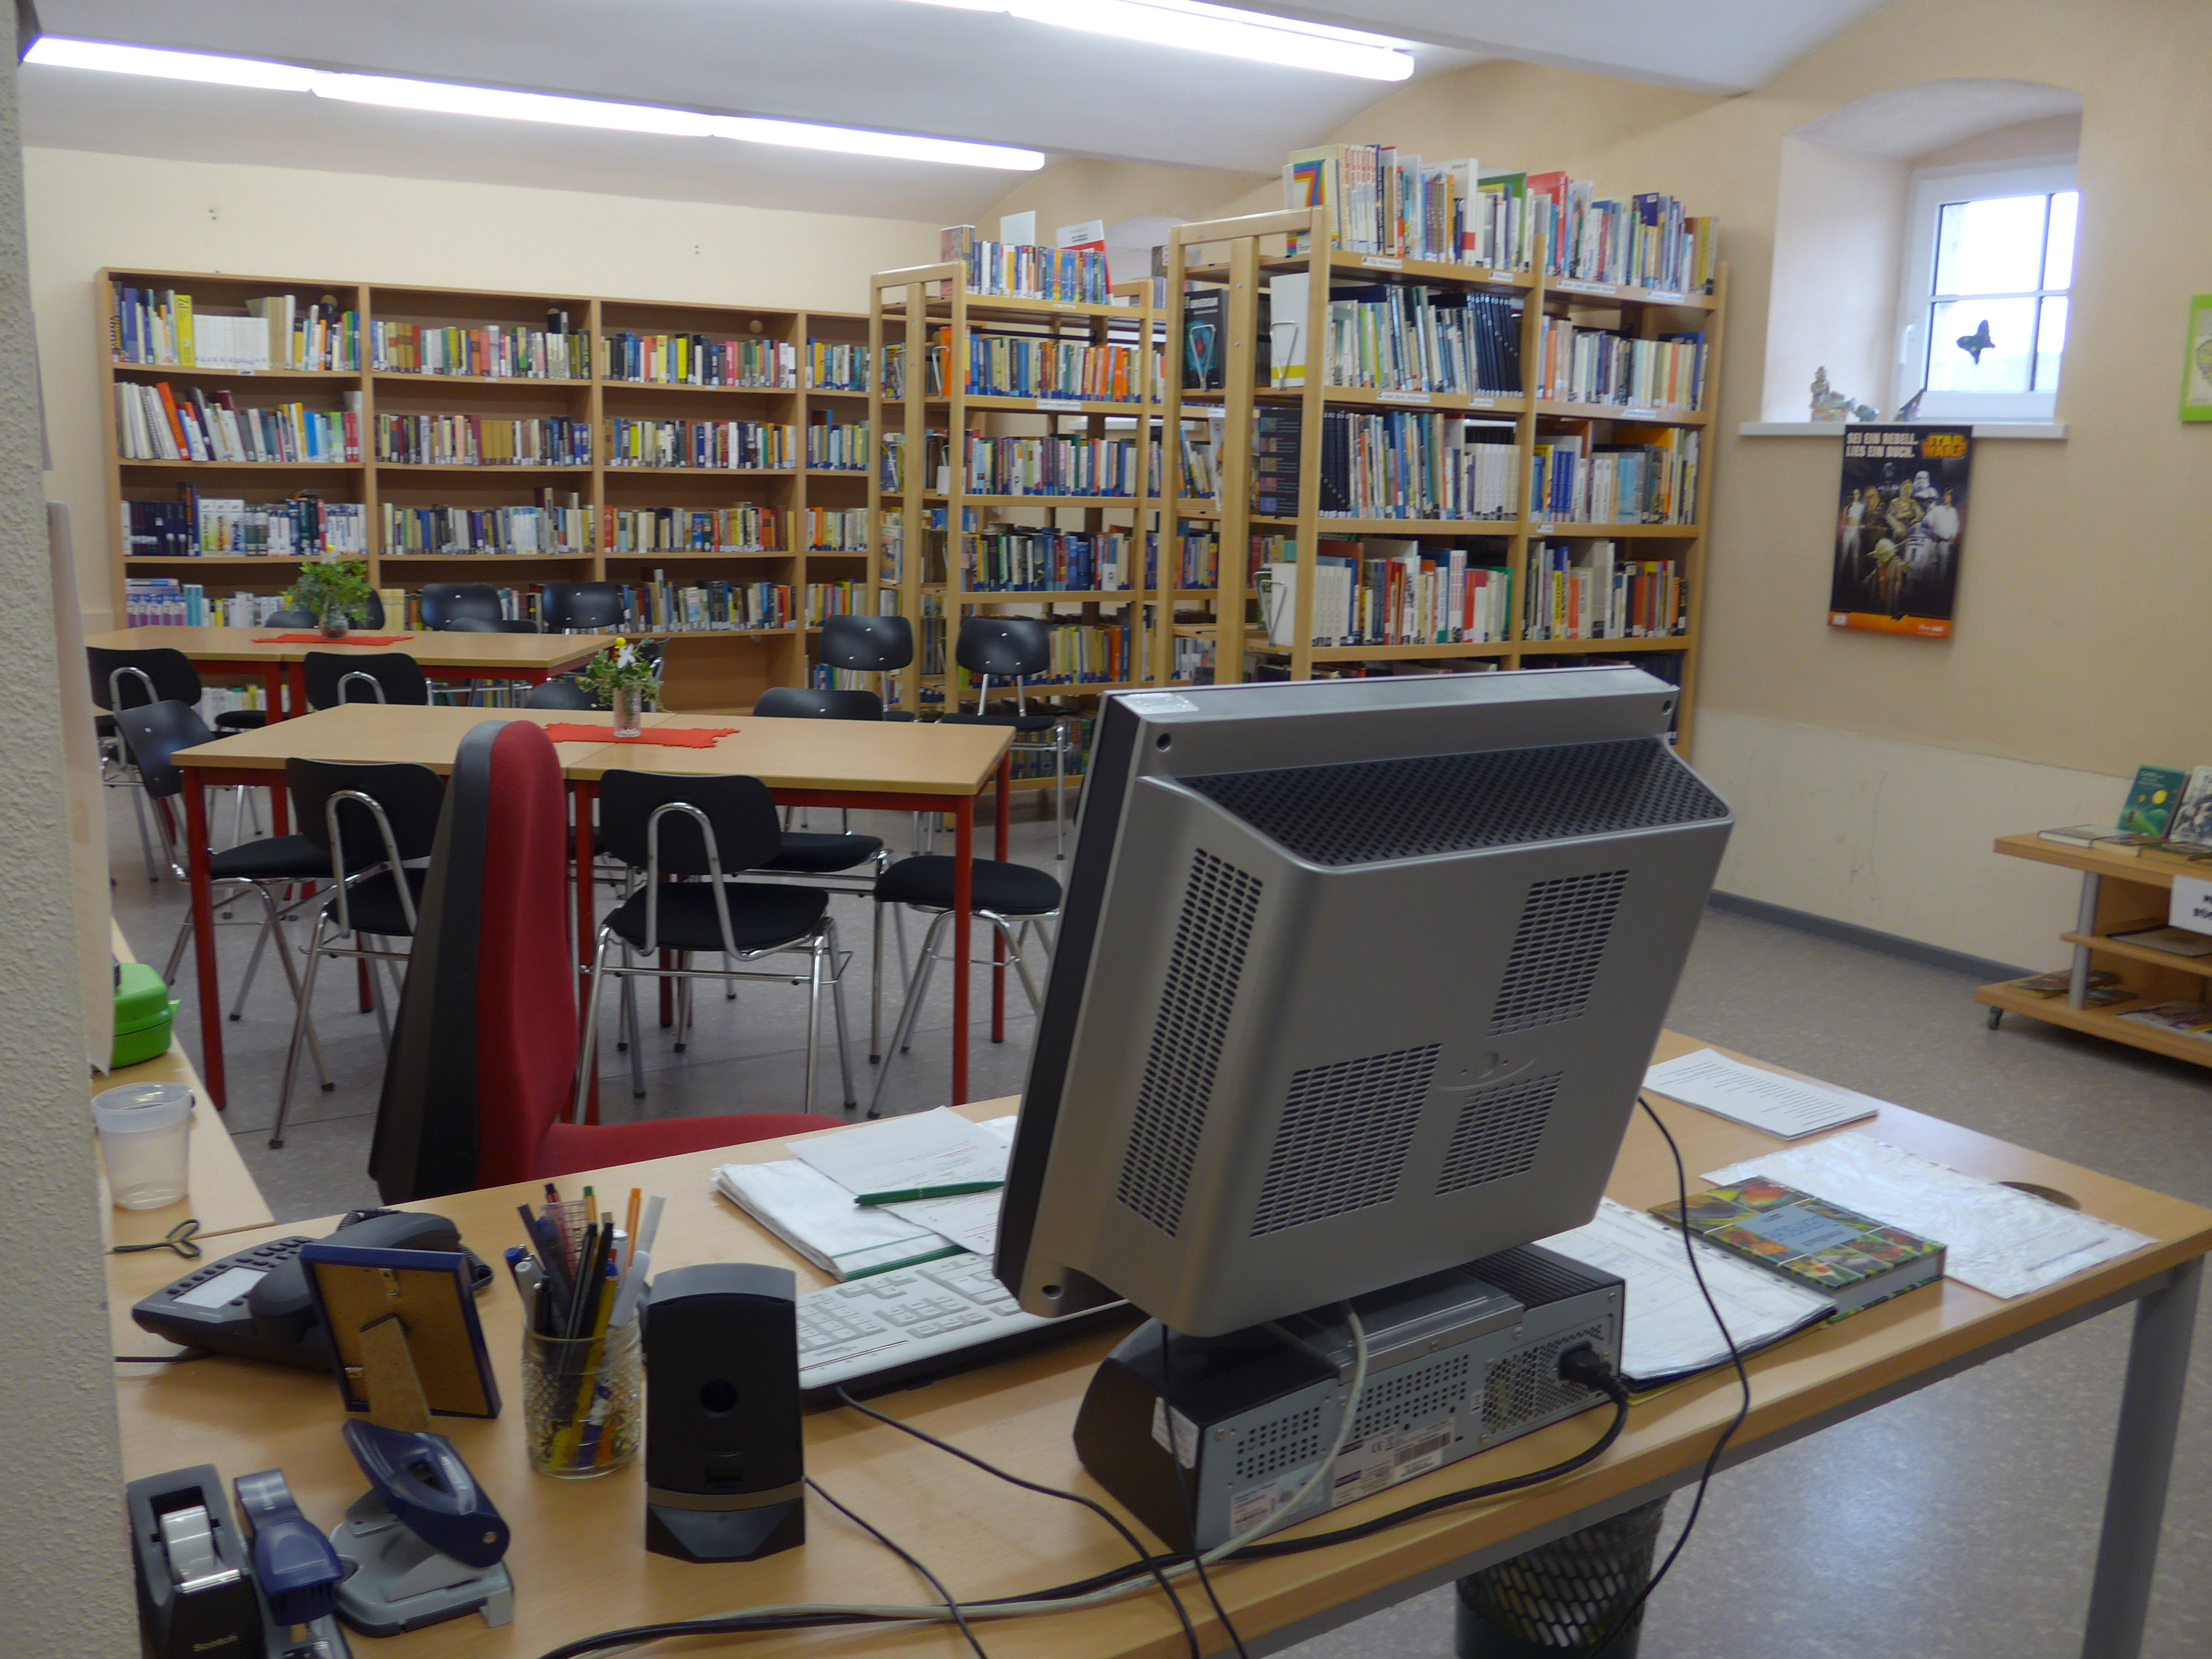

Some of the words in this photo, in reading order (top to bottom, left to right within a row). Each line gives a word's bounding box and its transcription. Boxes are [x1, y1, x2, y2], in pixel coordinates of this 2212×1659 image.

[1846, 432, 1863, 445] SEI
[1864, 432, 1881, 445] EIN
[1882, 432, 1919, 446] REBELL.
[1926, 434, 1966, 446] STAR
[1846, 445, 1866, 458] LIES
[1867, 445, 1885, 458] EIN
[1922, 444, 1966, 458] WARS
